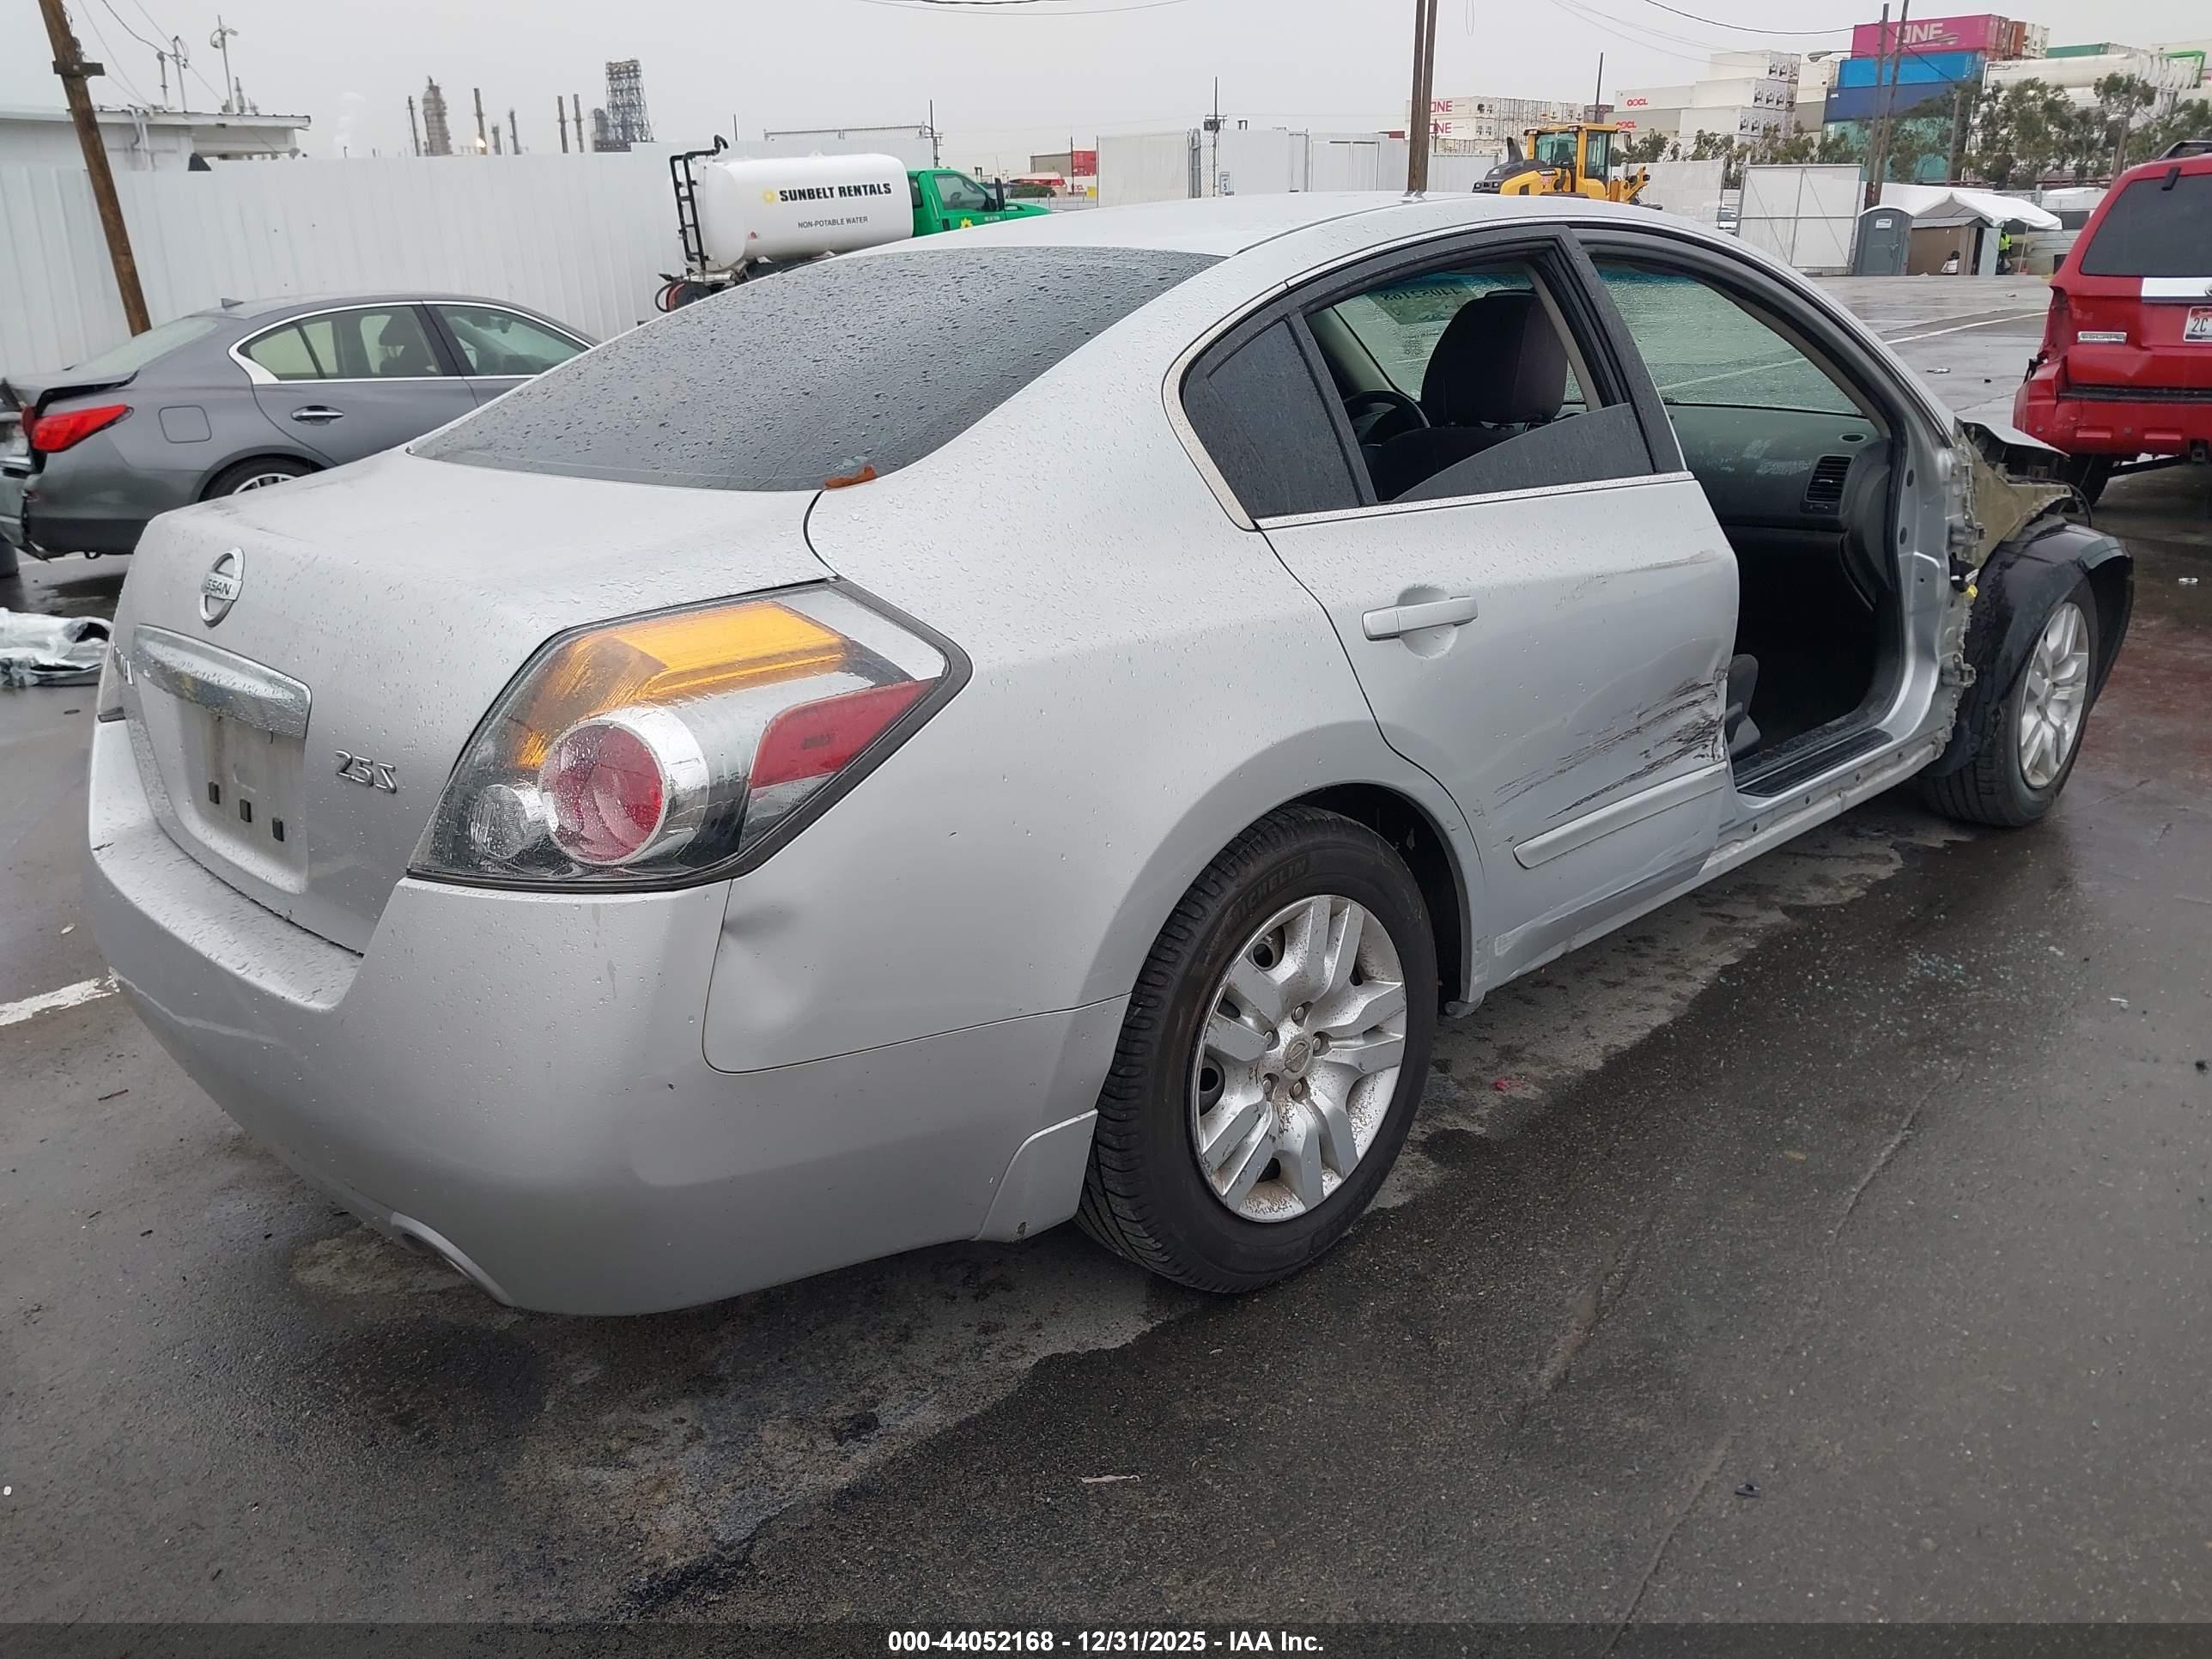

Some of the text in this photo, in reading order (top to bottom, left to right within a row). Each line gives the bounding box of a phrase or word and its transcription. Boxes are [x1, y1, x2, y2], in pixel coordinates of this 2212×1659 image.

[1626, 98, 1649, 106] OOCL
[779, 183, 892, 202] SUNBELT RENTALS
[798, 216, 869, 229] NON-POTABLE WATER
[205, 579, 233, 595] SSAN
